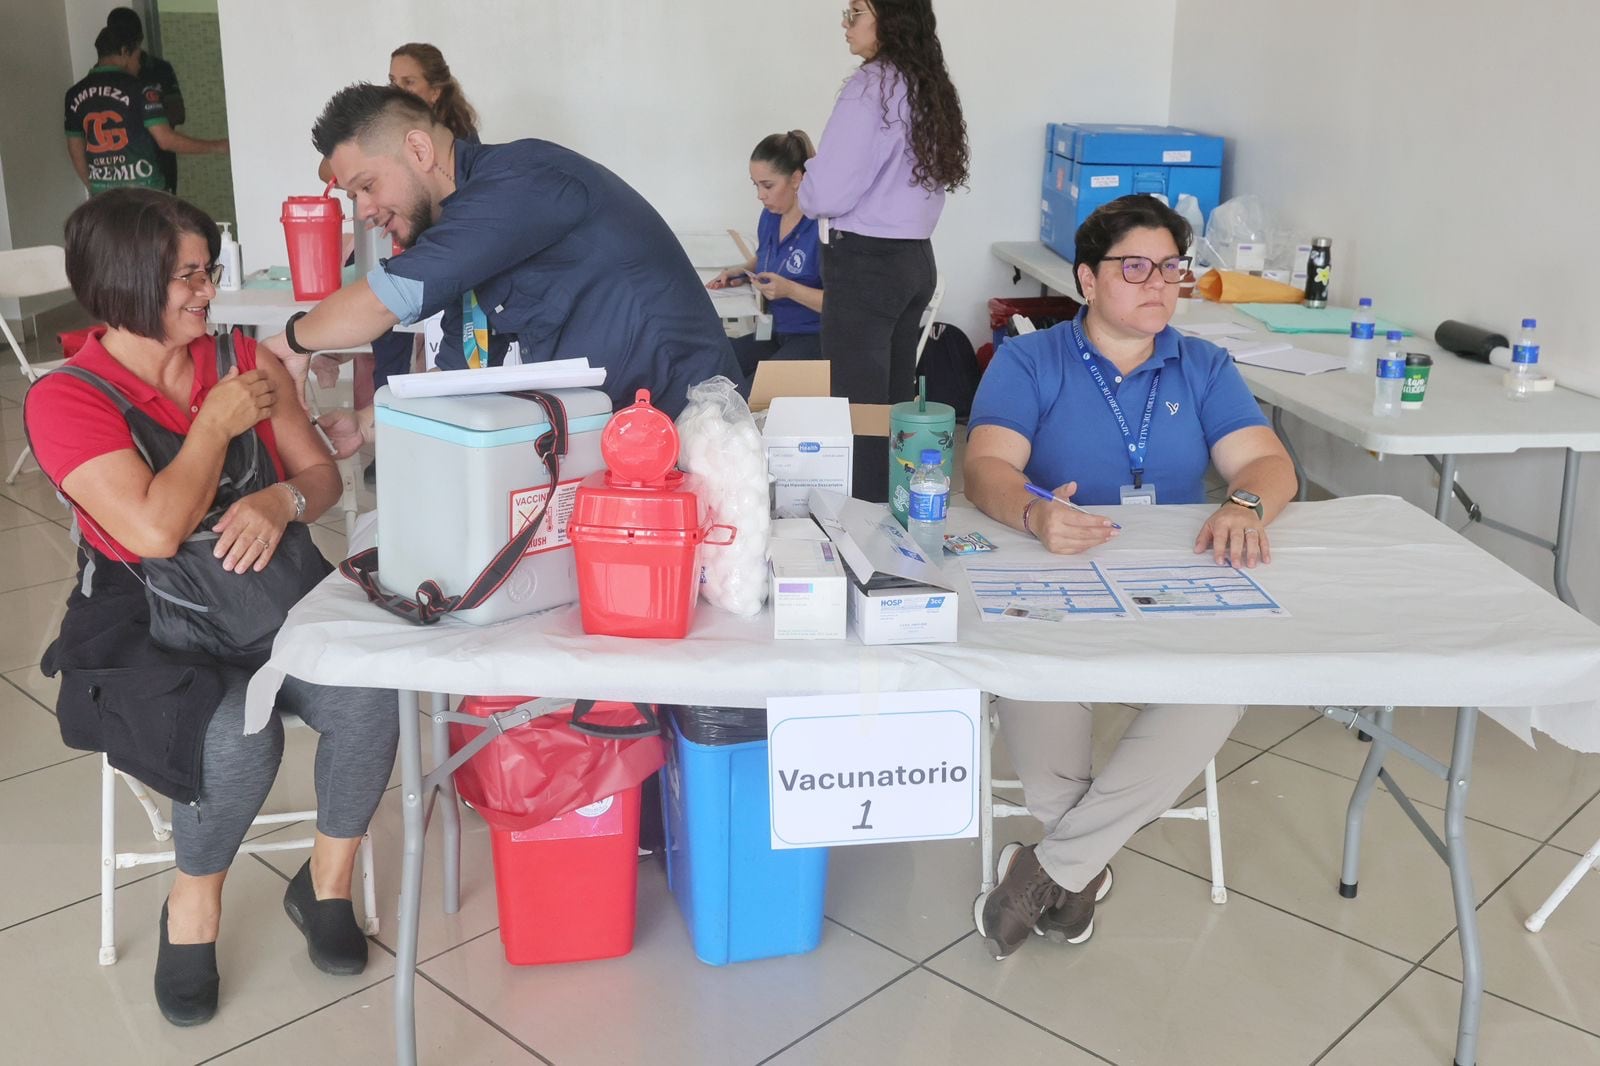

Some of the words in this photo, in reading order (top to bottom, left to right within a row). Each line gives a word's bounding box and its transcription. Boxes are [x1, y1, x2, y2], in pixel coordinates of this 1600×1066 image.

[70, 86, 130, 112] LIMPIEZA
[93, 155, 126, 166] GRUPO
[1090, 365, 1106, 387] SALUD
[1102, 386, 1111, 396] DE
[1138, 423, 1149, 449] SALUD
[515, 493, 548, 506] VACCIN
[528, 536, 547, 549] USH
[880, 599, 903, 607] HOSP
[778, 761, 968, 792] Vacunatorio
[852, 799, 873, 830] 1
